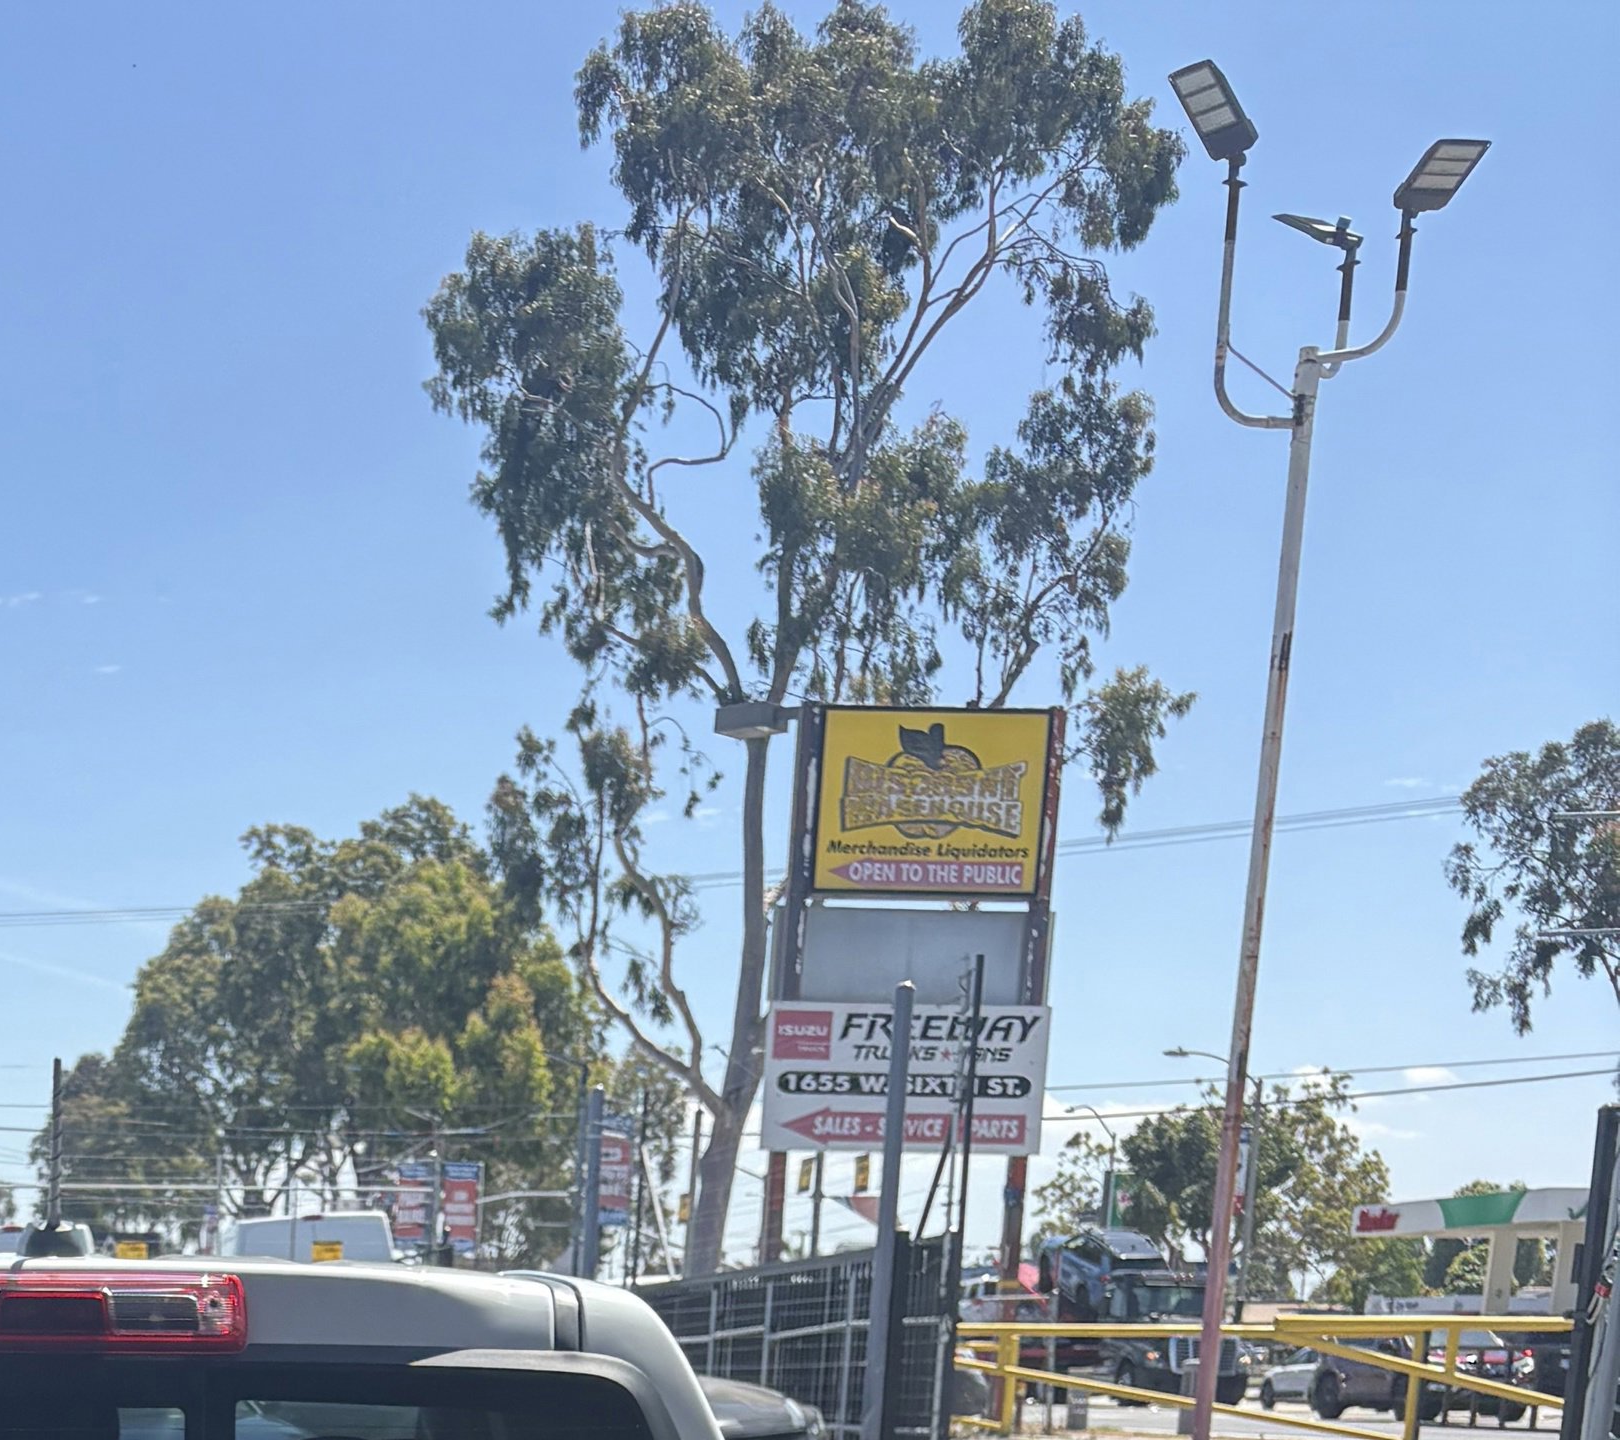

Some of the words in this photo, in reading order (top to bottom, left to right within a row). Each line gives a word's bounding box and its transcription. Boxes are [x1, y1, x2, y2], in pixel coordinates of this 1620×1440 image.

[827, 840, 932, 856] Merchandise
[937, 843, 1029, 860] Liquidators
[848, 863, 896, 882] OPEN
[900, 864, 923, 883] TO
[927, 864, 959, 883] THE
[963, 865, 1022, 884] PUBLIC
[777, 1025, 829, 1036] ISUZU
[785, 1074, 851, 1092] 1655
[986, 1078, 1022, 1096] ST.
[812, 1116, 861, 1136] SALES
[876, 1117, 944, 1138] SVICE
[971, 1119, 1018, 1139] PARTS
